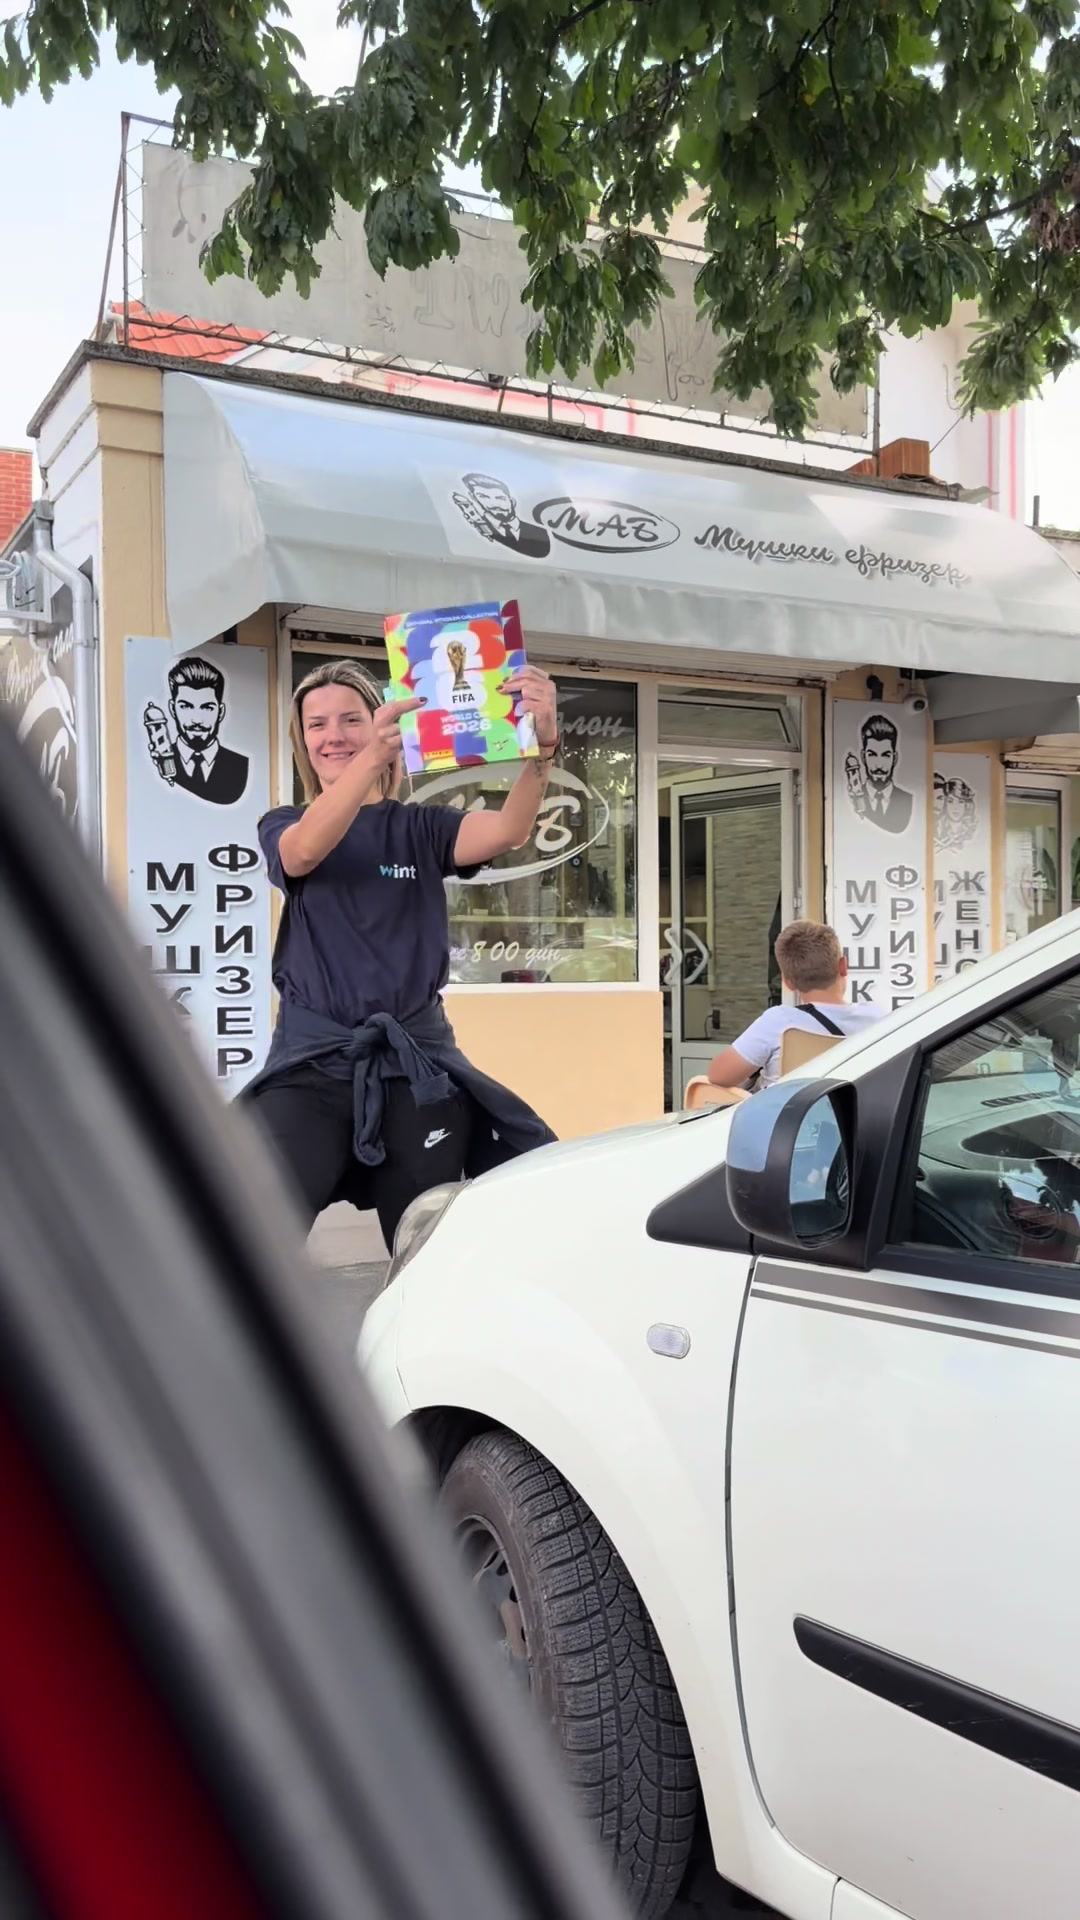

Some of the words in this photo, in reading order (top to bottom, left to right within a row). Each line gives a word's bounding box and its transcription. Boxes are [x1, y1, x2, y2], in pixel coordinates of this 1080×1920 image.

[693, 524, 833, 560] Мушки
[845, 544, 966, 585] фризер
[452, 693, 476, 704] FIFA
[441, 718, 492, 736] 2026
[379, 864, 416, 880] wint
[207, 843, 260, 1077] ФРИЗЕР
